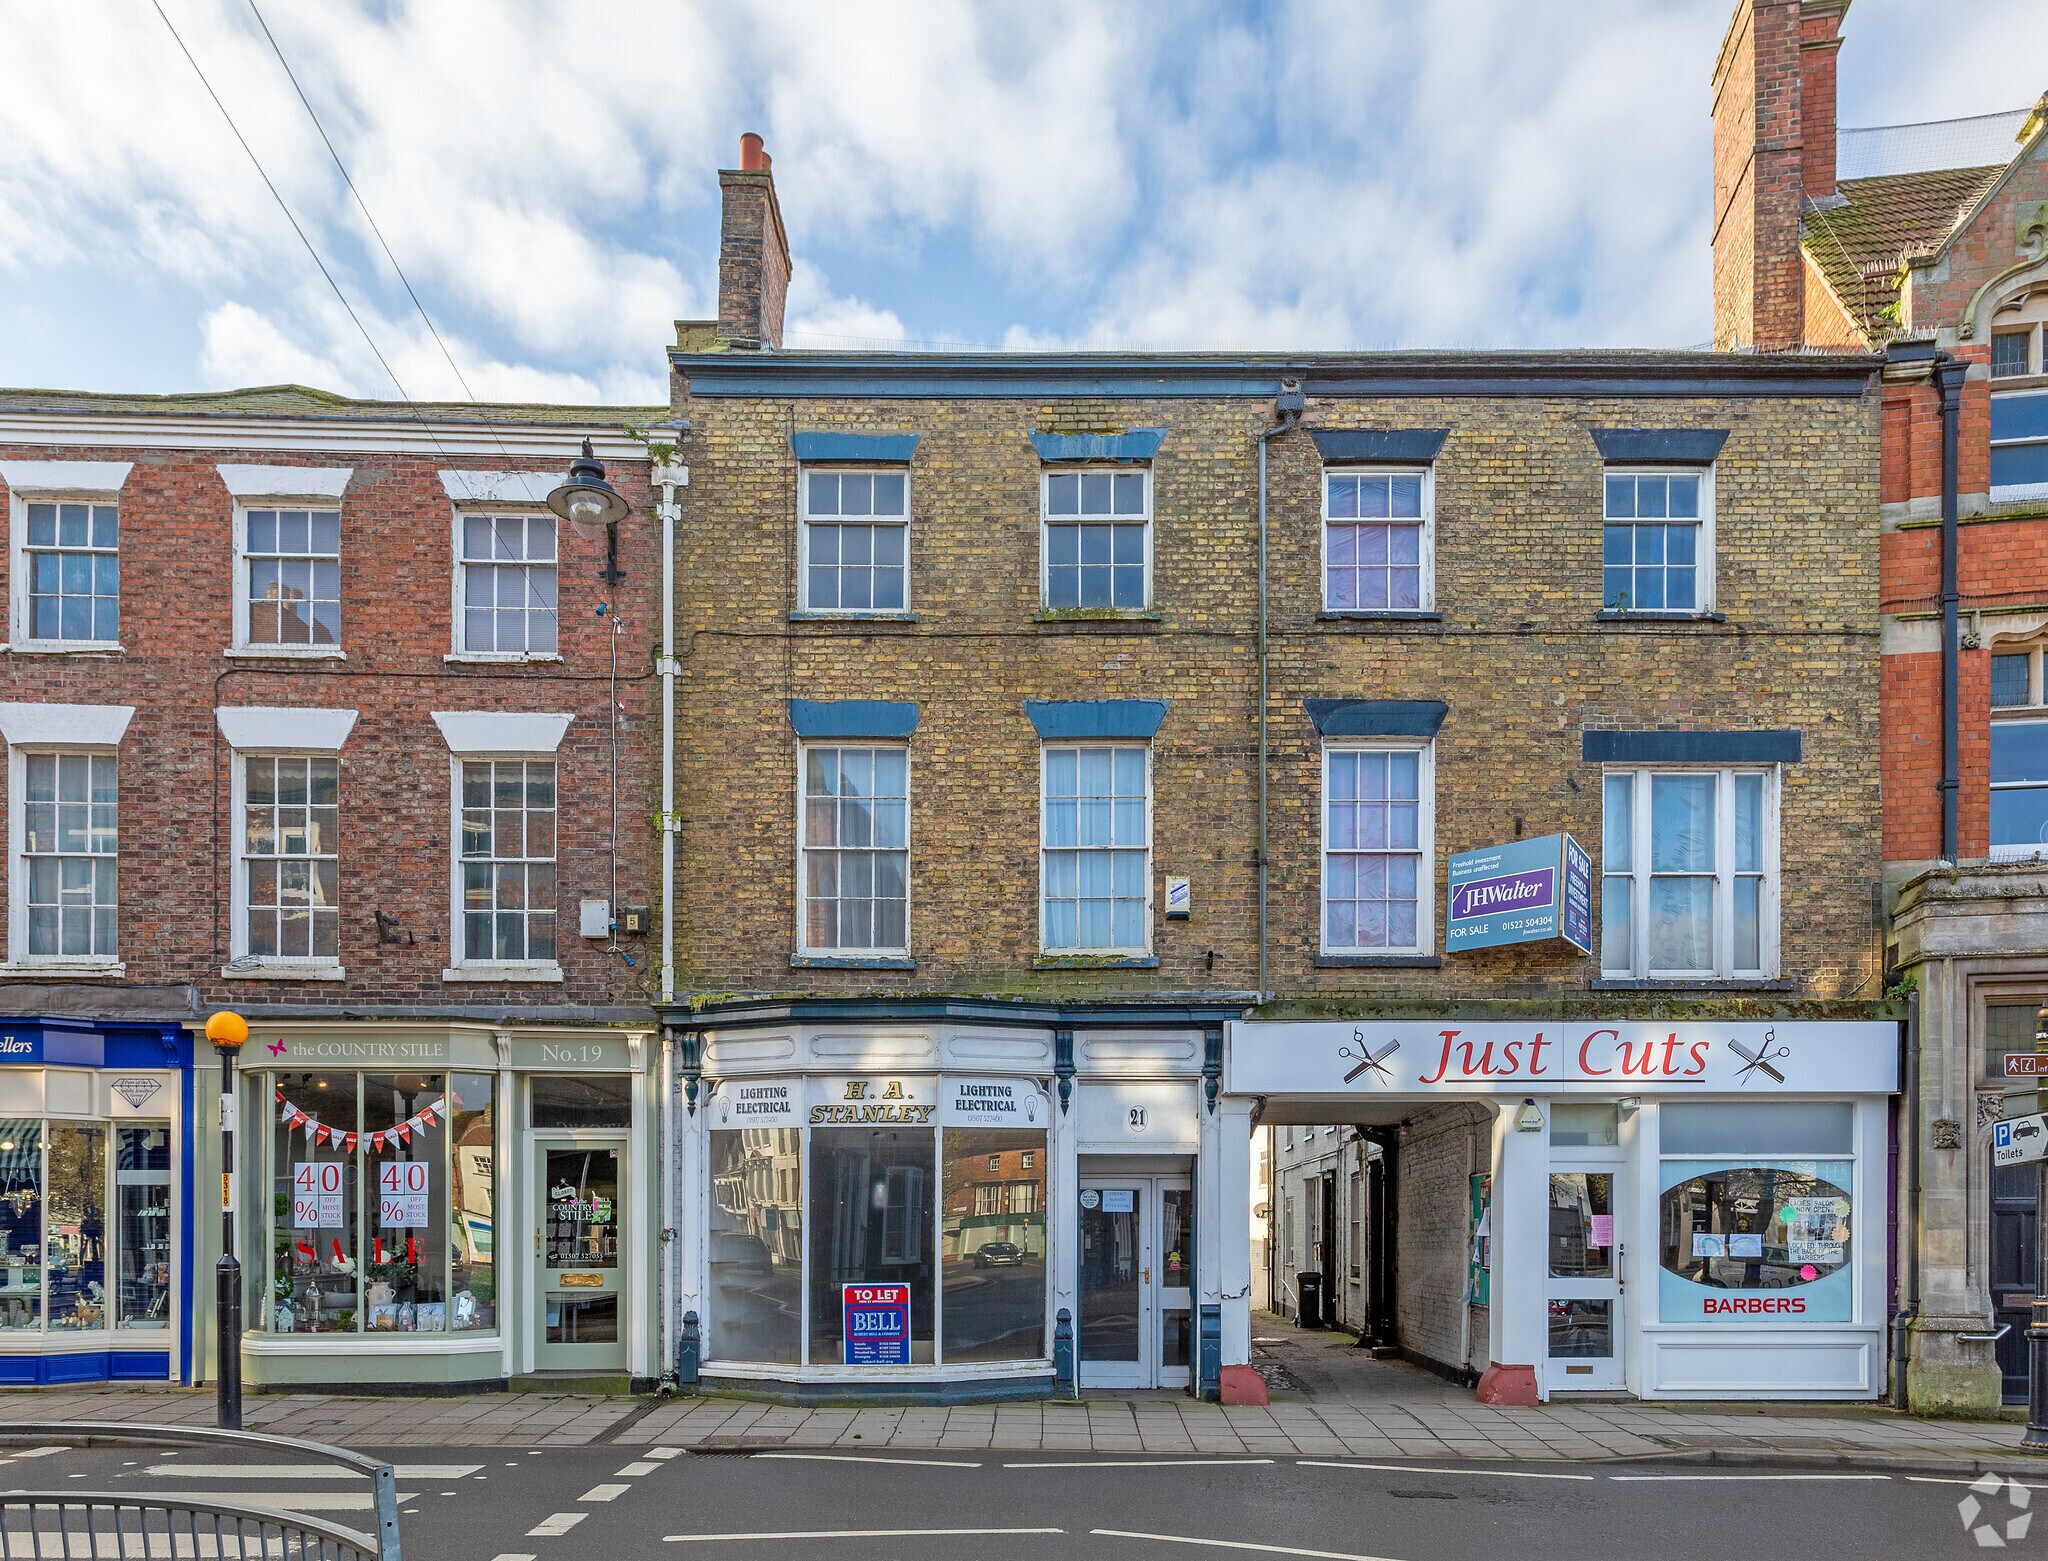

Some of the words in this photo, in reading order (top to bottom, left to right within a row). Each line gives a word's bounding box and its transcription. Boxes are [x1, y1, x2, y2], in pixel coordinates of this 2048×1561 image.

[1452, 858, 1474, 869] Freehold
[1474, 854, 1502, 865] investment
[1568, 843, 1578, 869] FOR
[1578, 854, 1589, 880] SALE
[1452, 868, 1472, 877] Business
[1473, 862, 1500, 873] unaffected
[1462, 880, 1543, 914] JHWalter
[629, 917, 636, 926] 5
[1502, 920, 1524, 931] 01522
[1525, 915, 1553, 928] 504304
[1450, 926, 1467, 939] FOR
[1469, 923, 1489, 935] SALE
[293, 1043, 315, 1056] the
[317, 1042, 398, 1057] COUNTRY
[400, 1042, 443, 1057] STILE
[1418, 1030, 1553, 1085] Just
[1578, 1029, 1710, 1077] Cuts
[740, 1086, 788, 1099] LIGHTING
[844, 1081, 876, 1100] H.
[882, 1081, 915, 1100] A.
[959, 1084, 1012, 1098] LIGHTING
[284, 1108, 293, 1116] SALE
[735, 1101, 792, 1114] ELECTRICAL
[955, 1099, 1017, 1112] ELECTRICAL
[293, 1115, 304, 1124] SALE
[422, 1113, 433, 1121] SALE
[809, 1104, 936, 1124] STANLEY
[1130, 1108, 1145, 1126] 21
[1998, 1125, 2008, 1146] P
[1996, 1147, 2023, 1161] Toilets
[296, 1165, 340, 1192] 40
[382, 1164, 426, 1192] 40
[554, 1189, 573, 1197] CLOSED
[295, 1201, 318, 1222] %
[381, 1201, 404, 1222] %
[552, 1203, 593, 1211] COUNTRY
[560, 1210, 593, 1221] STILE
[854, 1289, 873, 1300] TO
[877, 1289, 899, 1300] LET
[1703, 1297, 1806, 1314] BARBERS
[853, 1312, 901, 1331] BELL
